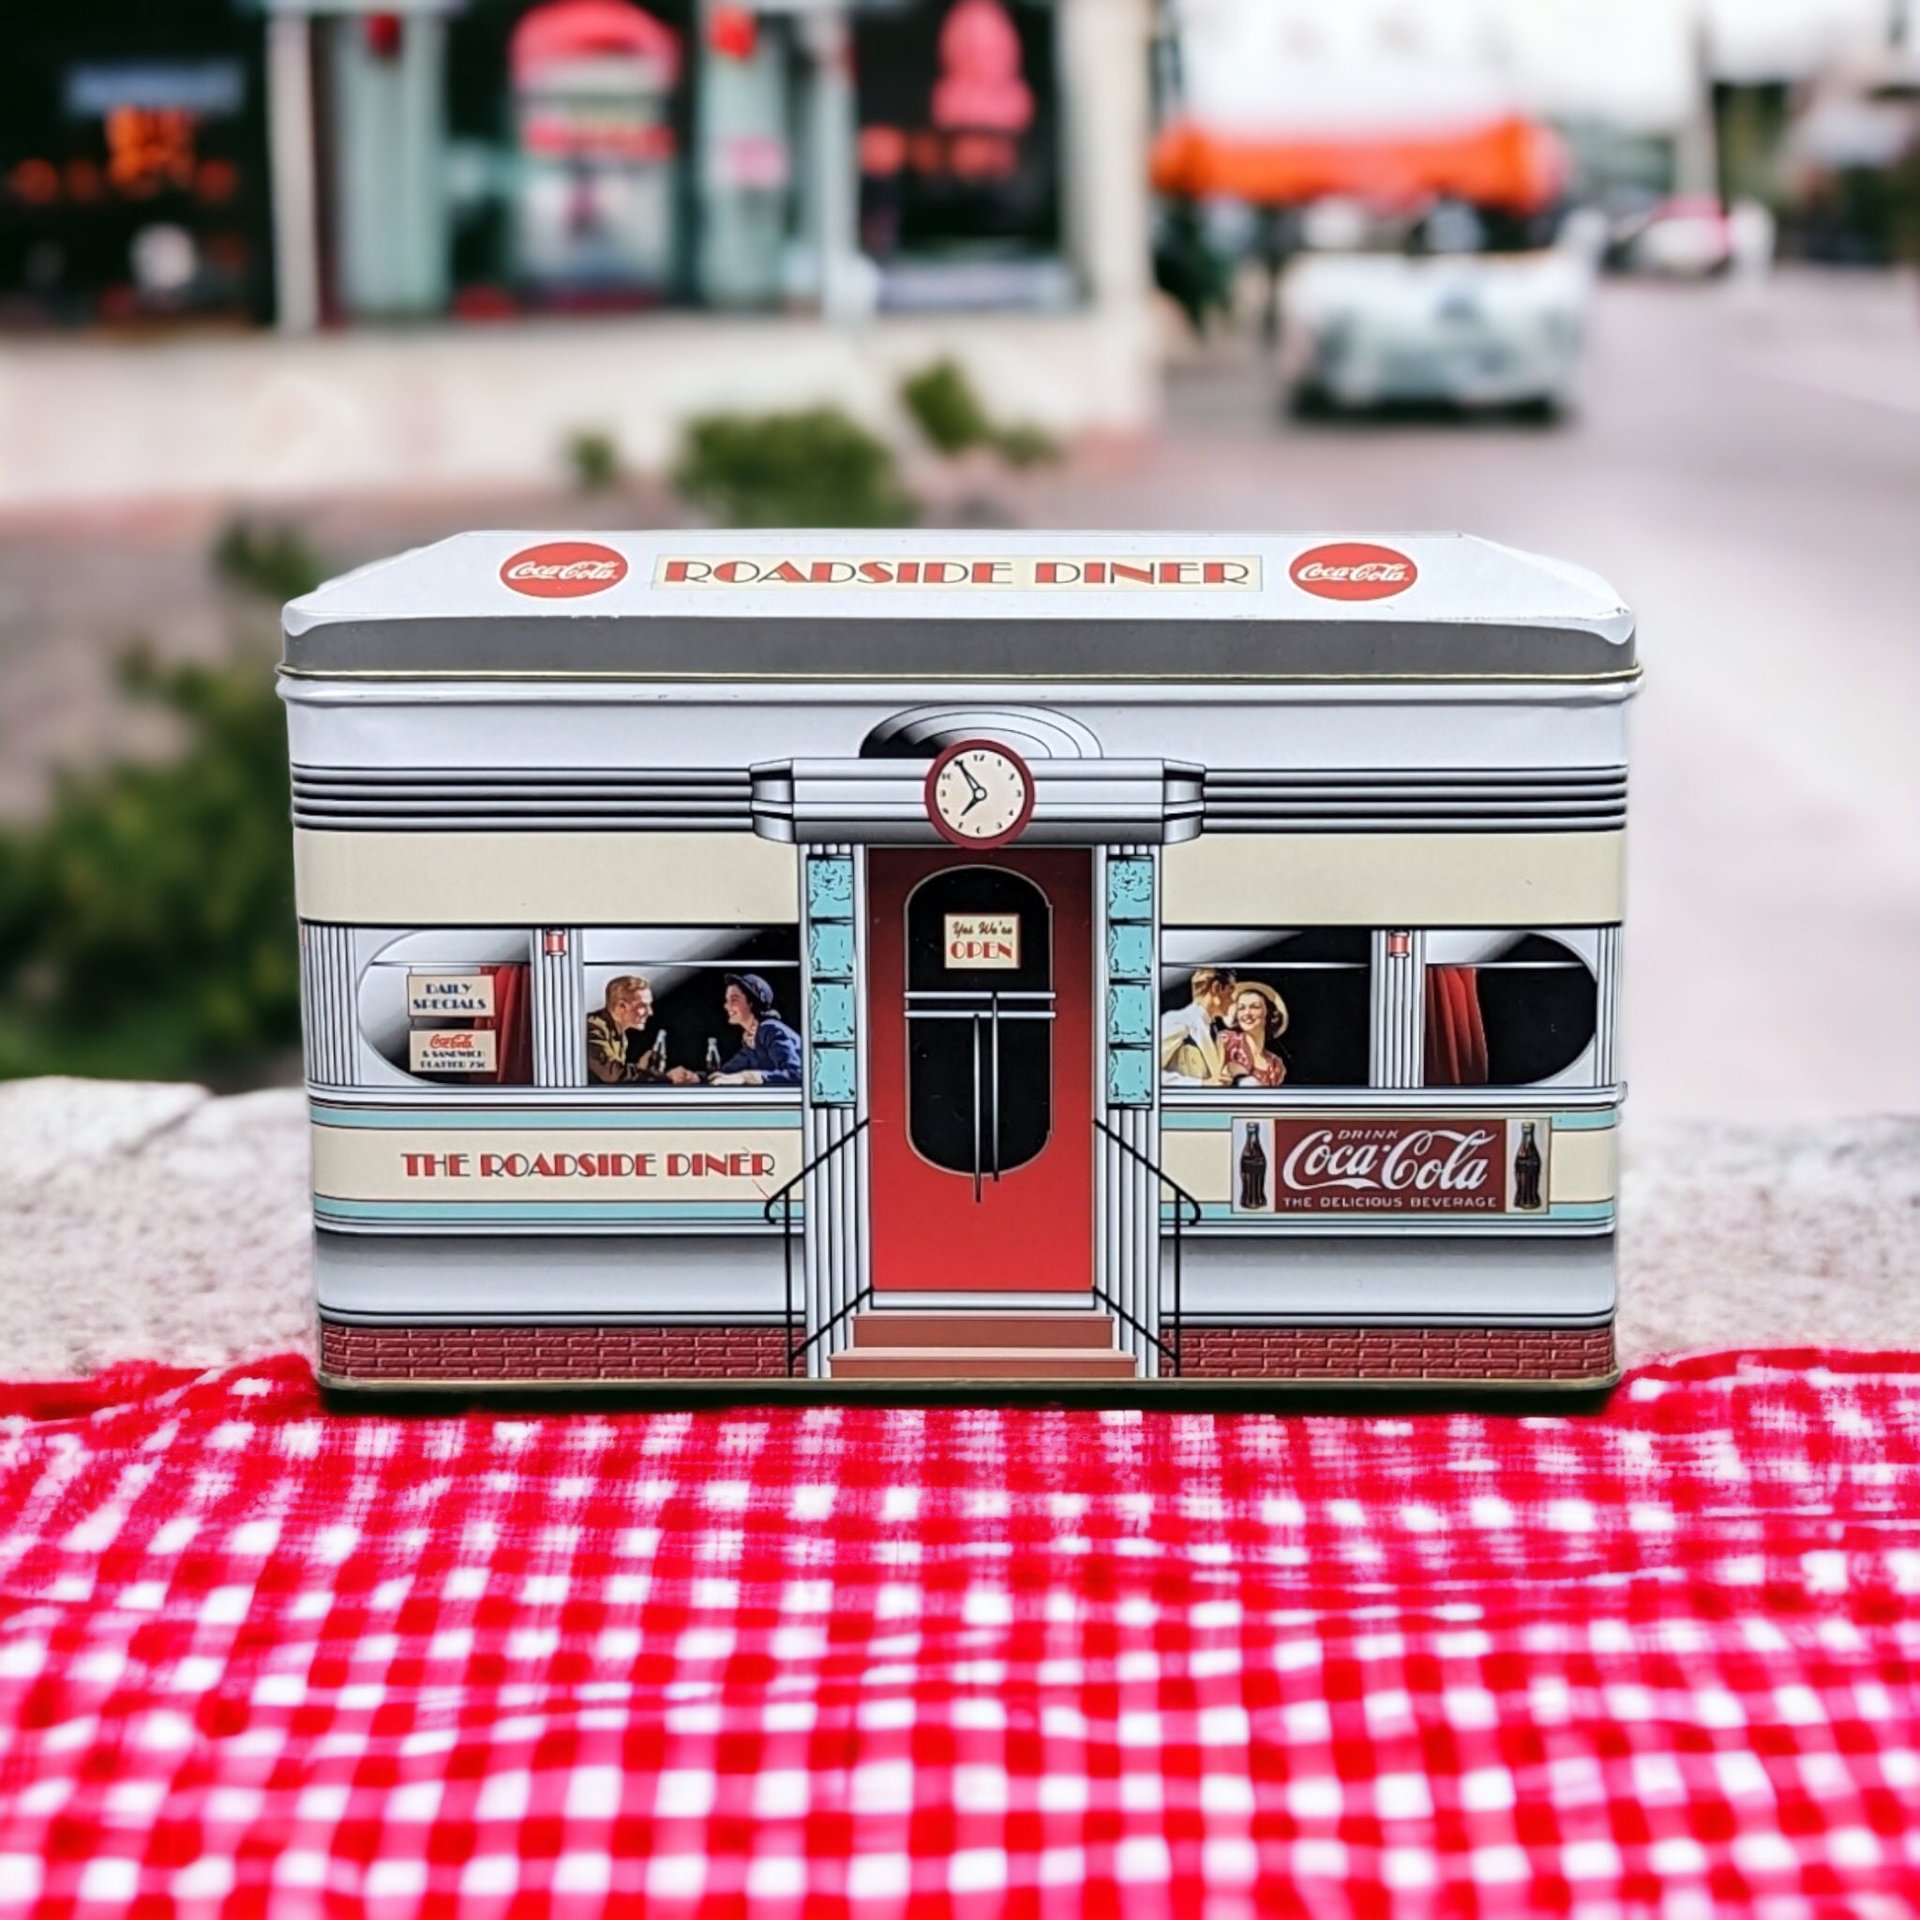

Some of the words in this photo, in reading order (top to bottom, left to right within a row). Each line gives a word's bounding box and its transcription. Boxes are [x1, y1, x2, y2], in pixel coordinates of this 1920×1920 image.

[664, 560, 1012, 584] ROADSIDE
[1035, 561, 1249, 585] DINER
[953, 921, 974, 939] Yes
[950, 941, 1013, 959] OPEN
[425, 983, 472, 995] DAILY
[412, 998, 488, 1010] SPECIALS
[1337, 1129, 1399, 1140] DRINK
[401, 1153, 471, 1177] THE
[480, 1153, 657, 1177] ROADSIDE
[667, 1153, 775, 1177] DINER
[1284, 1196, 1312, 1208] THE
[1320, 1196, 1403, 1208] DELICIOUS
[1411, 1196, 1497, 1208] BEVERAGE
